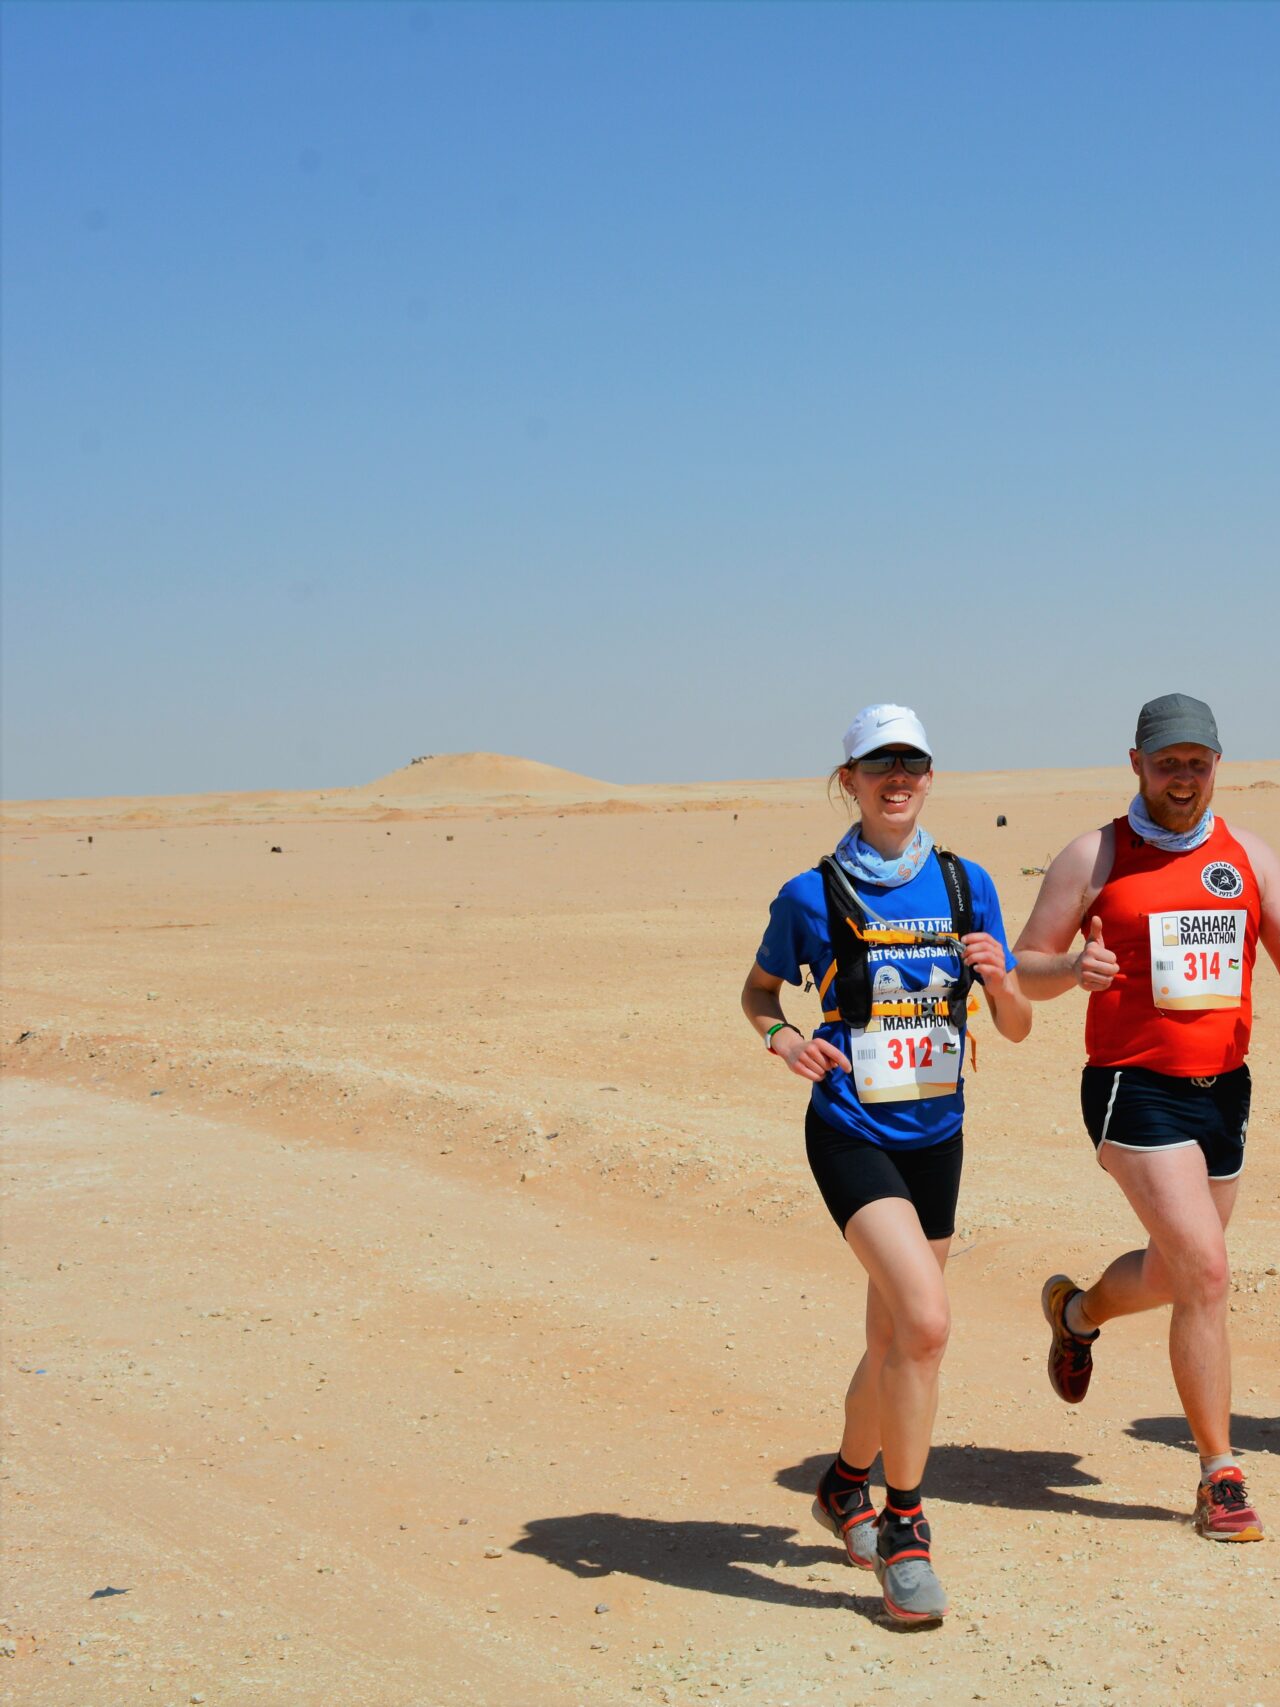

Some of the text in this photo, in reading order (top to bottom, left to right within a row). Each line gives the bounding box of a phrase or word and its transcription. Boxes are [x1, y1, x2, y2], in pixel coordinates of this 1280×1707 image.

[899, 920, 952, 933] MARATHO
[1180, 916, 1236, 932] SAHARA
[1181, 932, 1236, 945] MARATHON
[884, 945, 905, 960] FÖR
[1184, 952, 1220, 981] 314
[883, 1013, 950, 1031] MARATHON
[887, 1037, 933, 1070] 312
